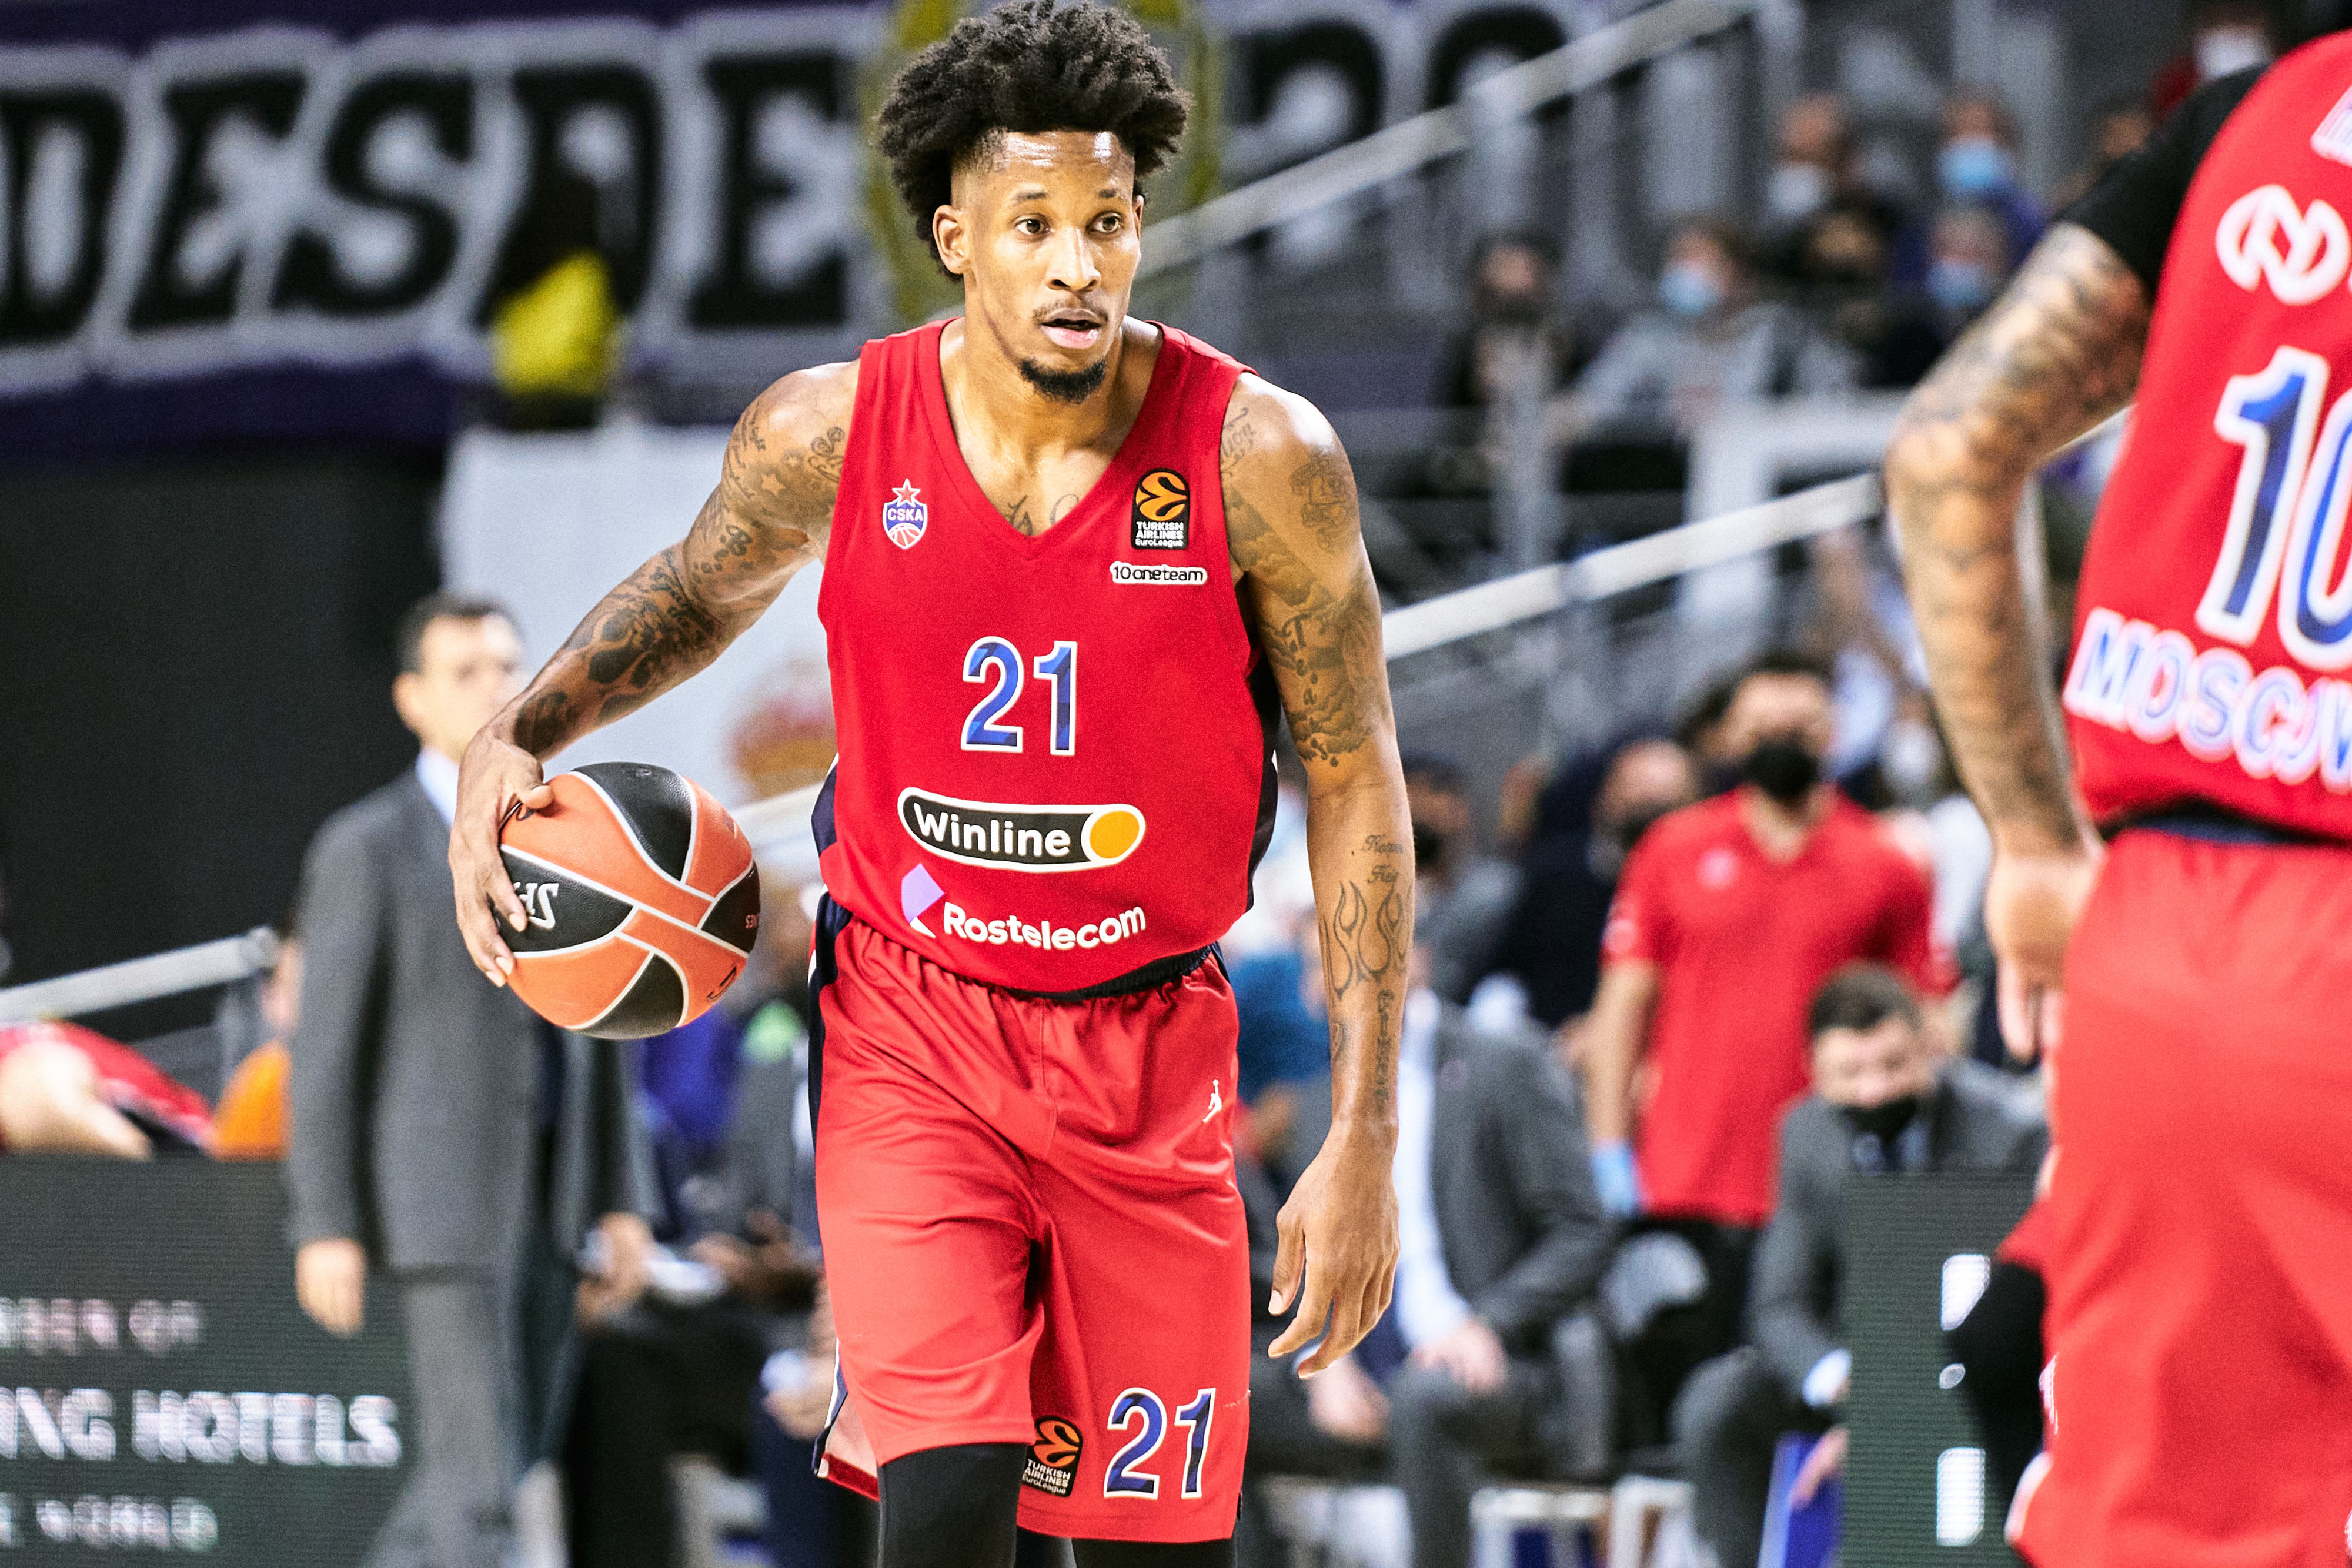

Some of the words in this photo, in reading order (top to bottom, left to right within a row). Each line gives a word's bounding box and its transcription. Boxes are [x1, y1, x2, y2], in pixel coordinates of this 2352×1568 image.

[887, 507, 923, 521] CSKA
[1136, 521, 1184, 531] TURKISH
[1136, 530, 1184, 539] AIRLINES
[1135, 538, 1184, 547] EuroLeague
[961, 636, 1077, 756] 21
[913, 803, 1070, 857] Winline
[943, 901, 1145, 950] Rostelecom
[132, 1389, 402, 1467] HOTELS
[1104, 1387, 1216, 1499] 21
[1024, 1467, 1069, 1489] AIRLINES
[1028, 1459, 1071, 1480] TURKISH
[1022, 1473, 1067, 1494] EuroLeague
